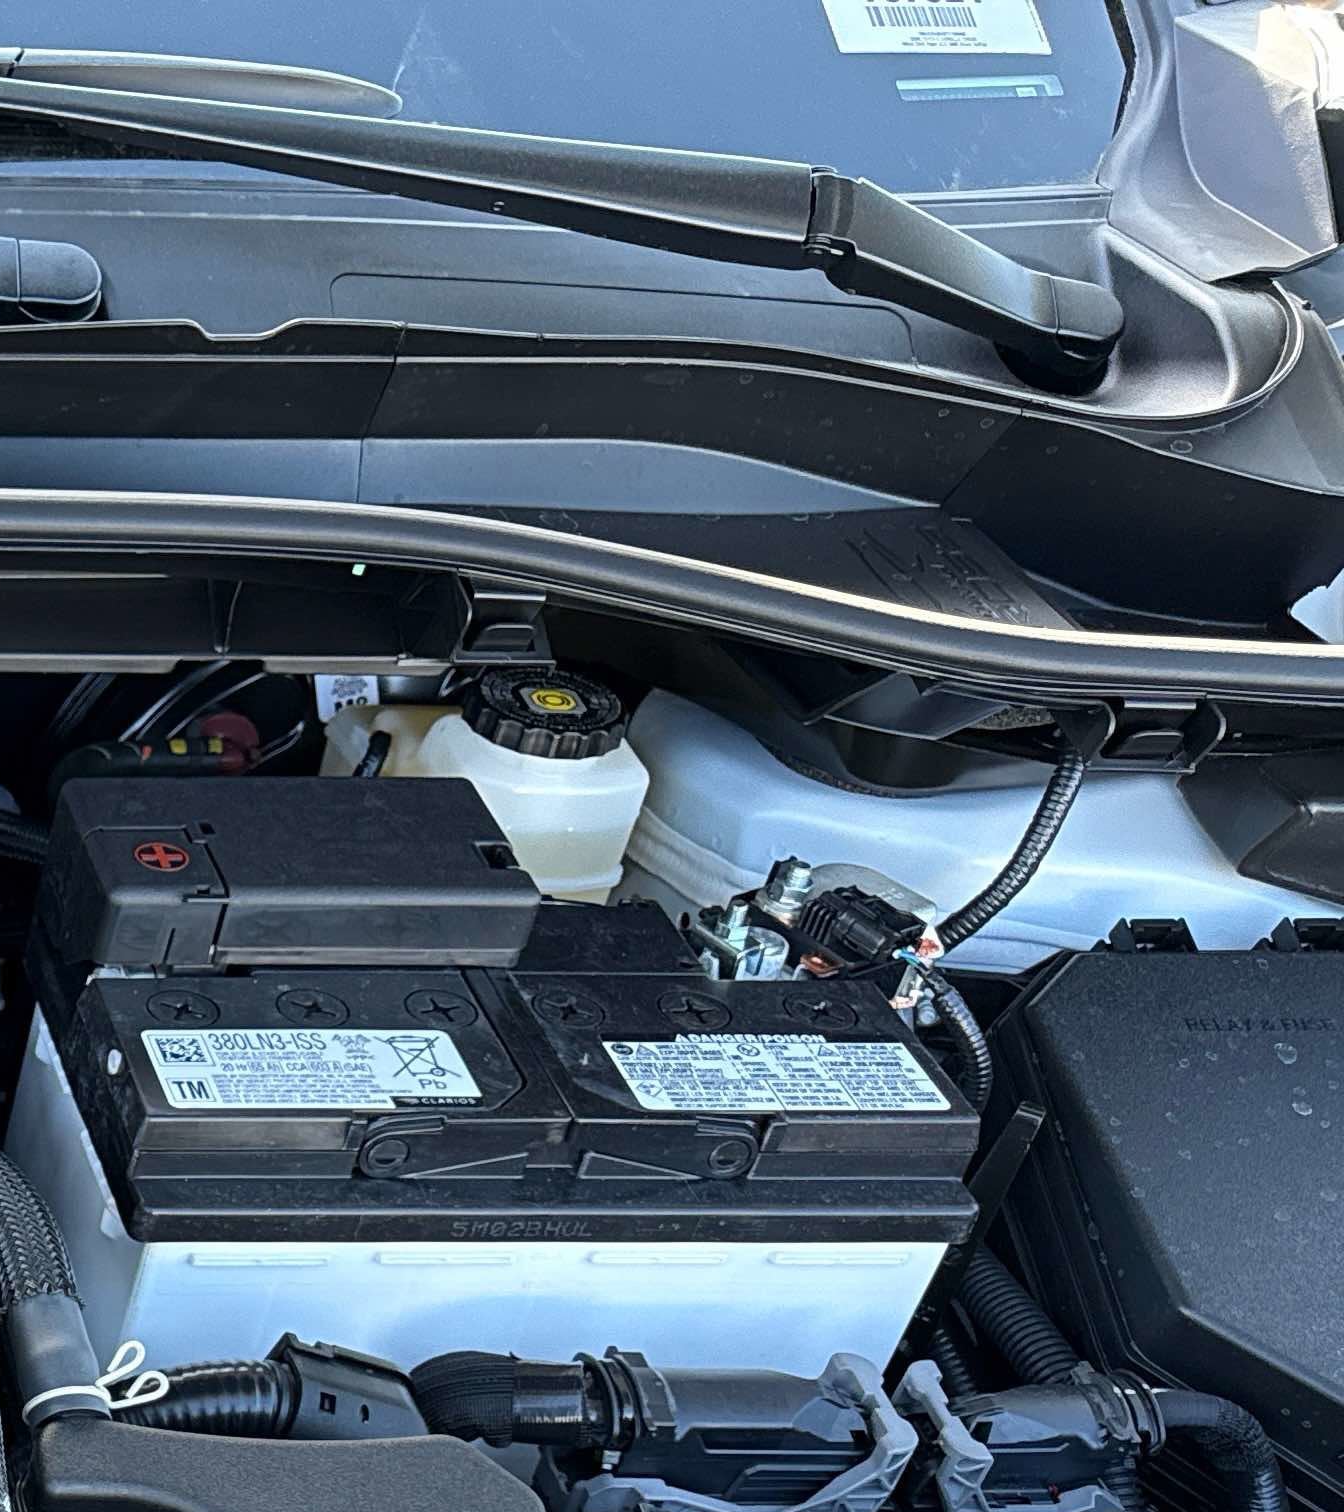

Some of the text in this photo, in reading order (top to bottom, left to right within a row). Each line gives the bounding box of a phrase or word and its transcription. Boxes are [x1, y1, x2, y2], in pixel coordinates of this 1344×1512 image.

[208, 1032, 327, 1050] 380LN3-ISS
[172, 1081, 210, 1099] TM
[419, 1078, 447, 1090] Pb
[421, 1097, 477, 1105] CLARIOS
